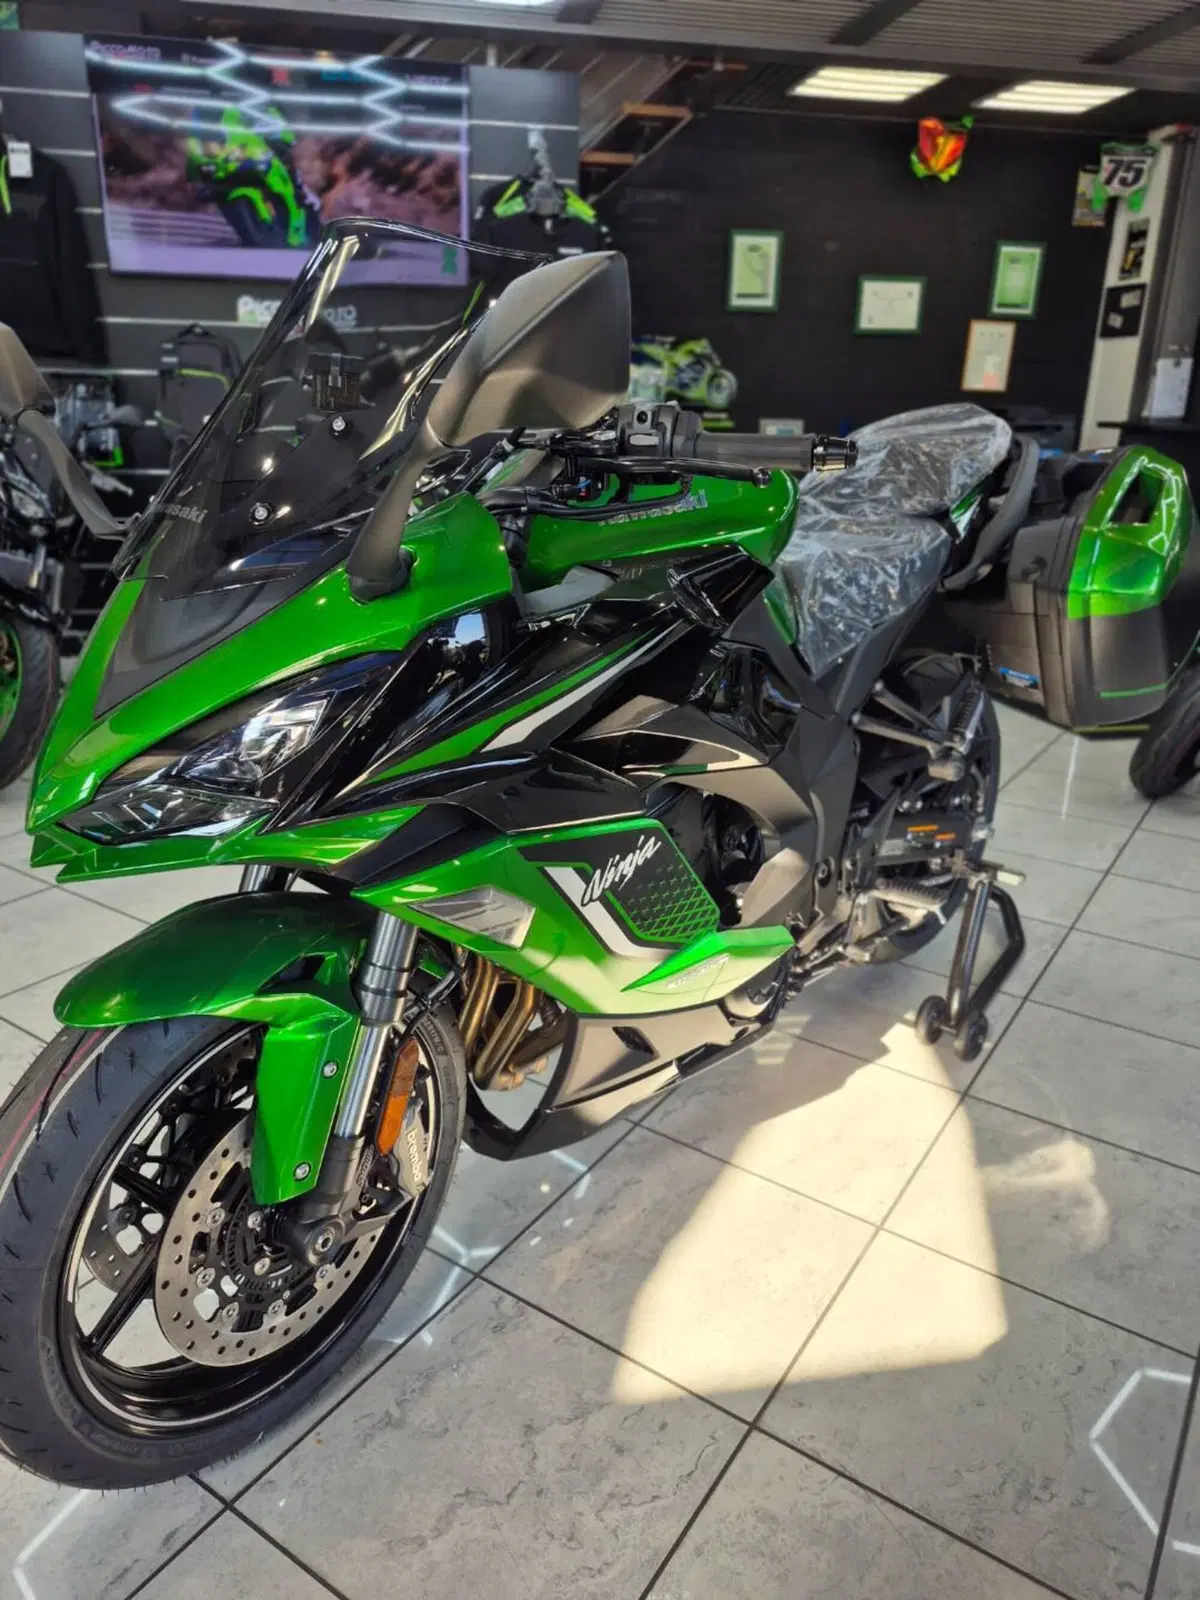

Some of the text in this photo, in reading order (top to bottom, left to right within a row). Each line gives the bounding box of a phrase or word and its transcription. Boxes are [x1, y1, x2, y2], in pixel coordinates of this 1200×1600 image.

[1104, 159, 1146, 187] 75
[580, 834, 662, 907] Ninja
[406, 1128, 422, 1182] brembo
